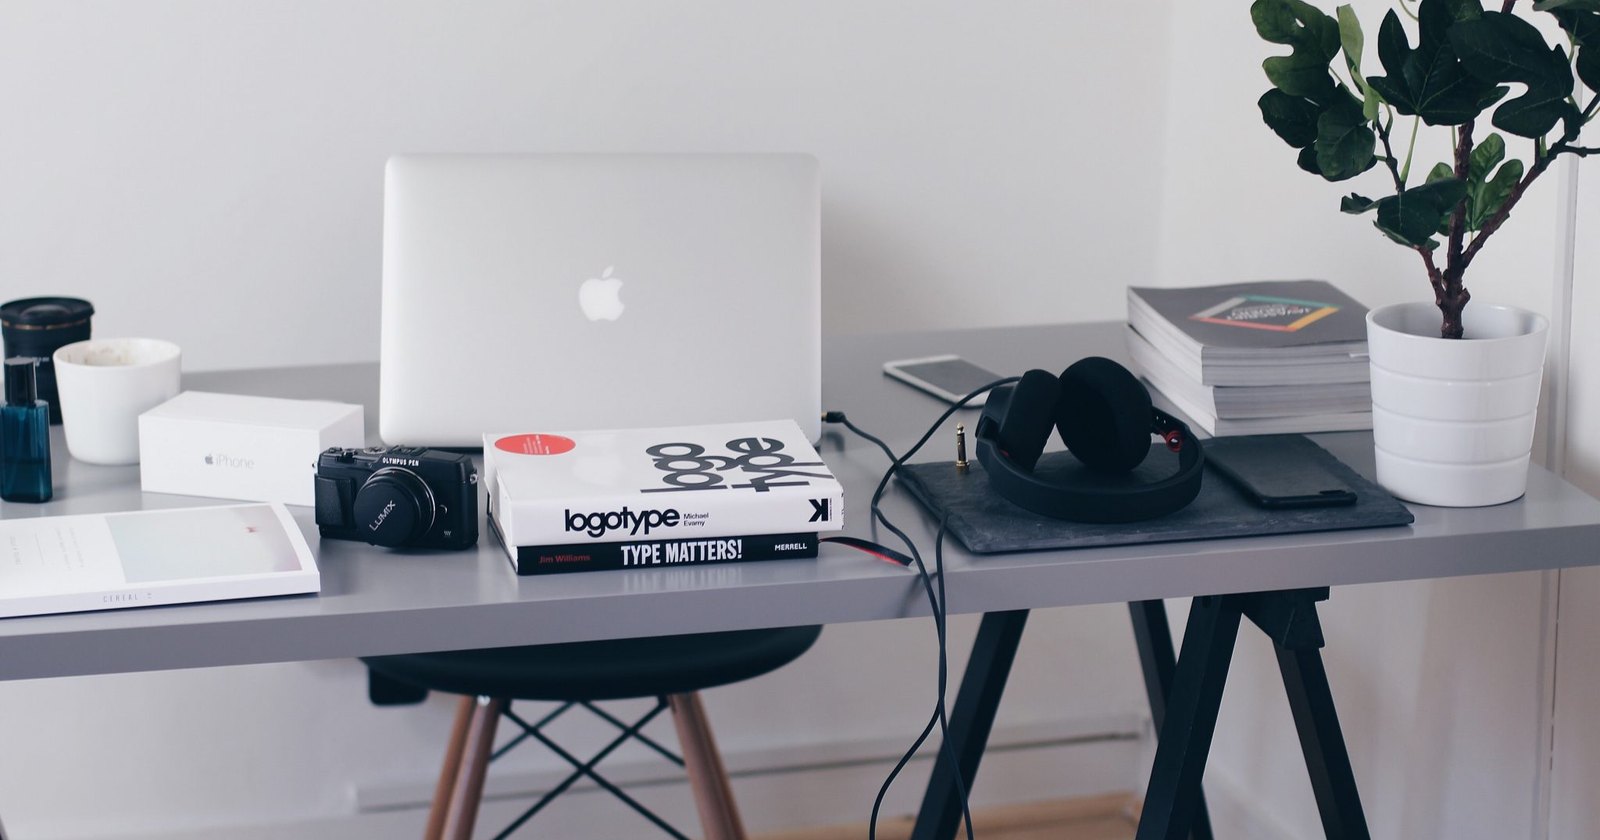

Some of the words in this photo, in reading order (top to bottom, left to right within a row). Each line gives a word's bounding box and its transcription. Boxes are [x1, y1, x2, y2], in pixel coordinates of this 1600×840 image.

[216, 455, 255, 469] iPhone
[382, 457, 407, 466] OLYMPUS
[408, 459, 419, 467] PEN
[369, 499, 396, 531] LUMIX
[683, 512, 709, 520] Michael
[565, 506, 681, 538] logotype
[621, 543, 661, 566] TYPE
[665, 539, 742, 563] MATTERS!
[774, 542, 808, 552] MERRELL
[539, 555, 554, 564] Jim
[555, 554, 591, 564] Williams
